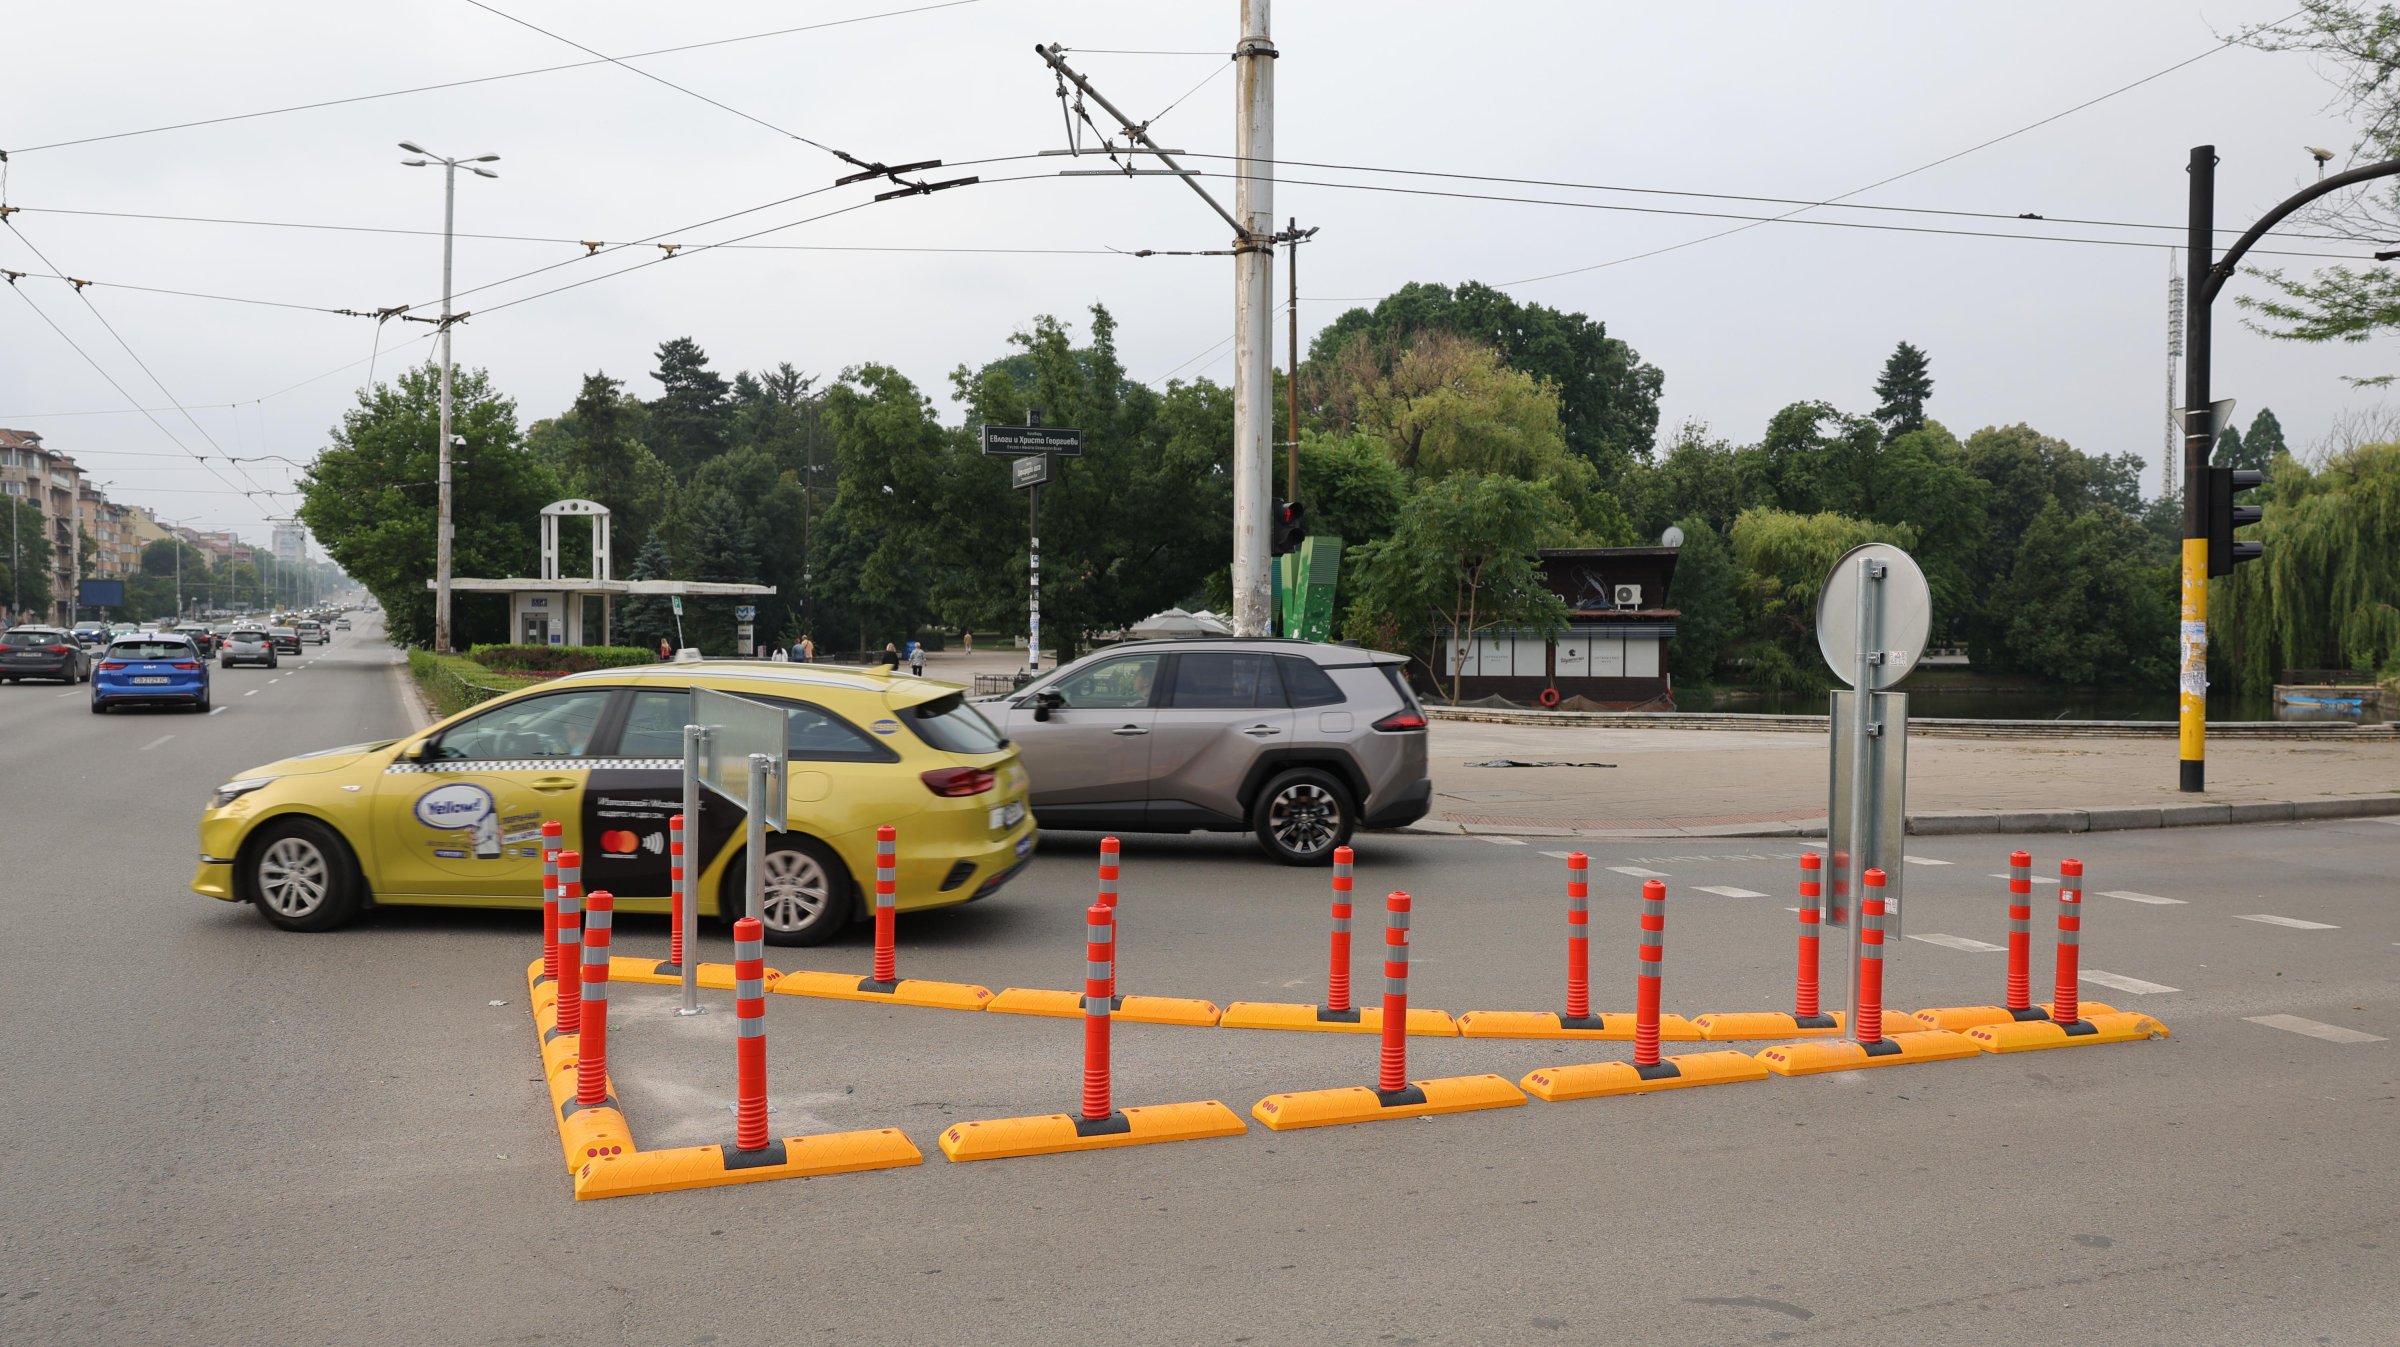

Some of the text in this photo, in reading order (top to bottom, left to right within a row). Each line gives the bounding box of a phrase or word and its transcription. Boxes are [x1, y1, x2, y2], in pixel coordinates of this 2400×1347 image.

[990, 434, 1012, 443] Евлоги
[1019, 435, 1044, 445] Христо
[1046, 437, 1078, 446] Георгиеви
[426, 797, 482, 815] Yellow!
